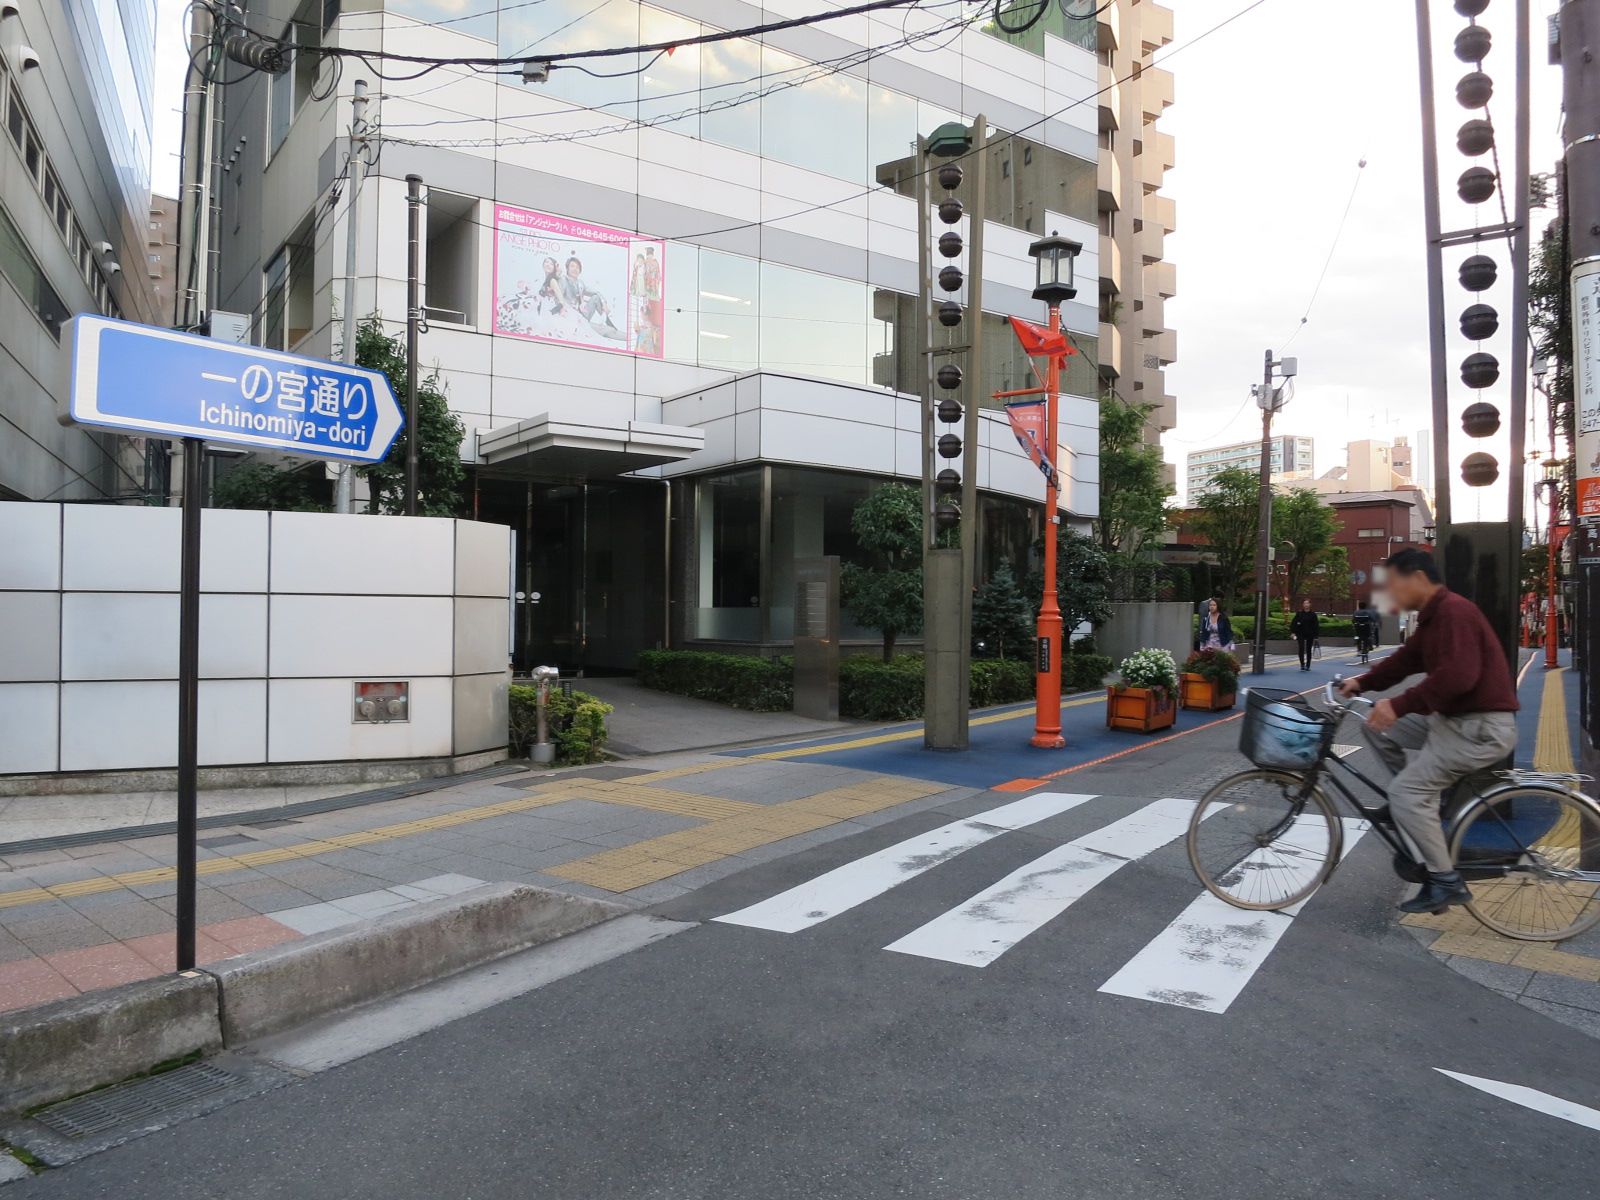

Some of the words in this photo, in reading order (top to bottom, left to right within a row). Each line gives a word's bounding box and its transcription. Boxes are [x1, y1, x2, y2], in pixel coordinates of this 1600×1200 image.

[201, 364, 368, 420] 一の宮通り
[200, 400, 367, 446] Ichinomiya-dori
